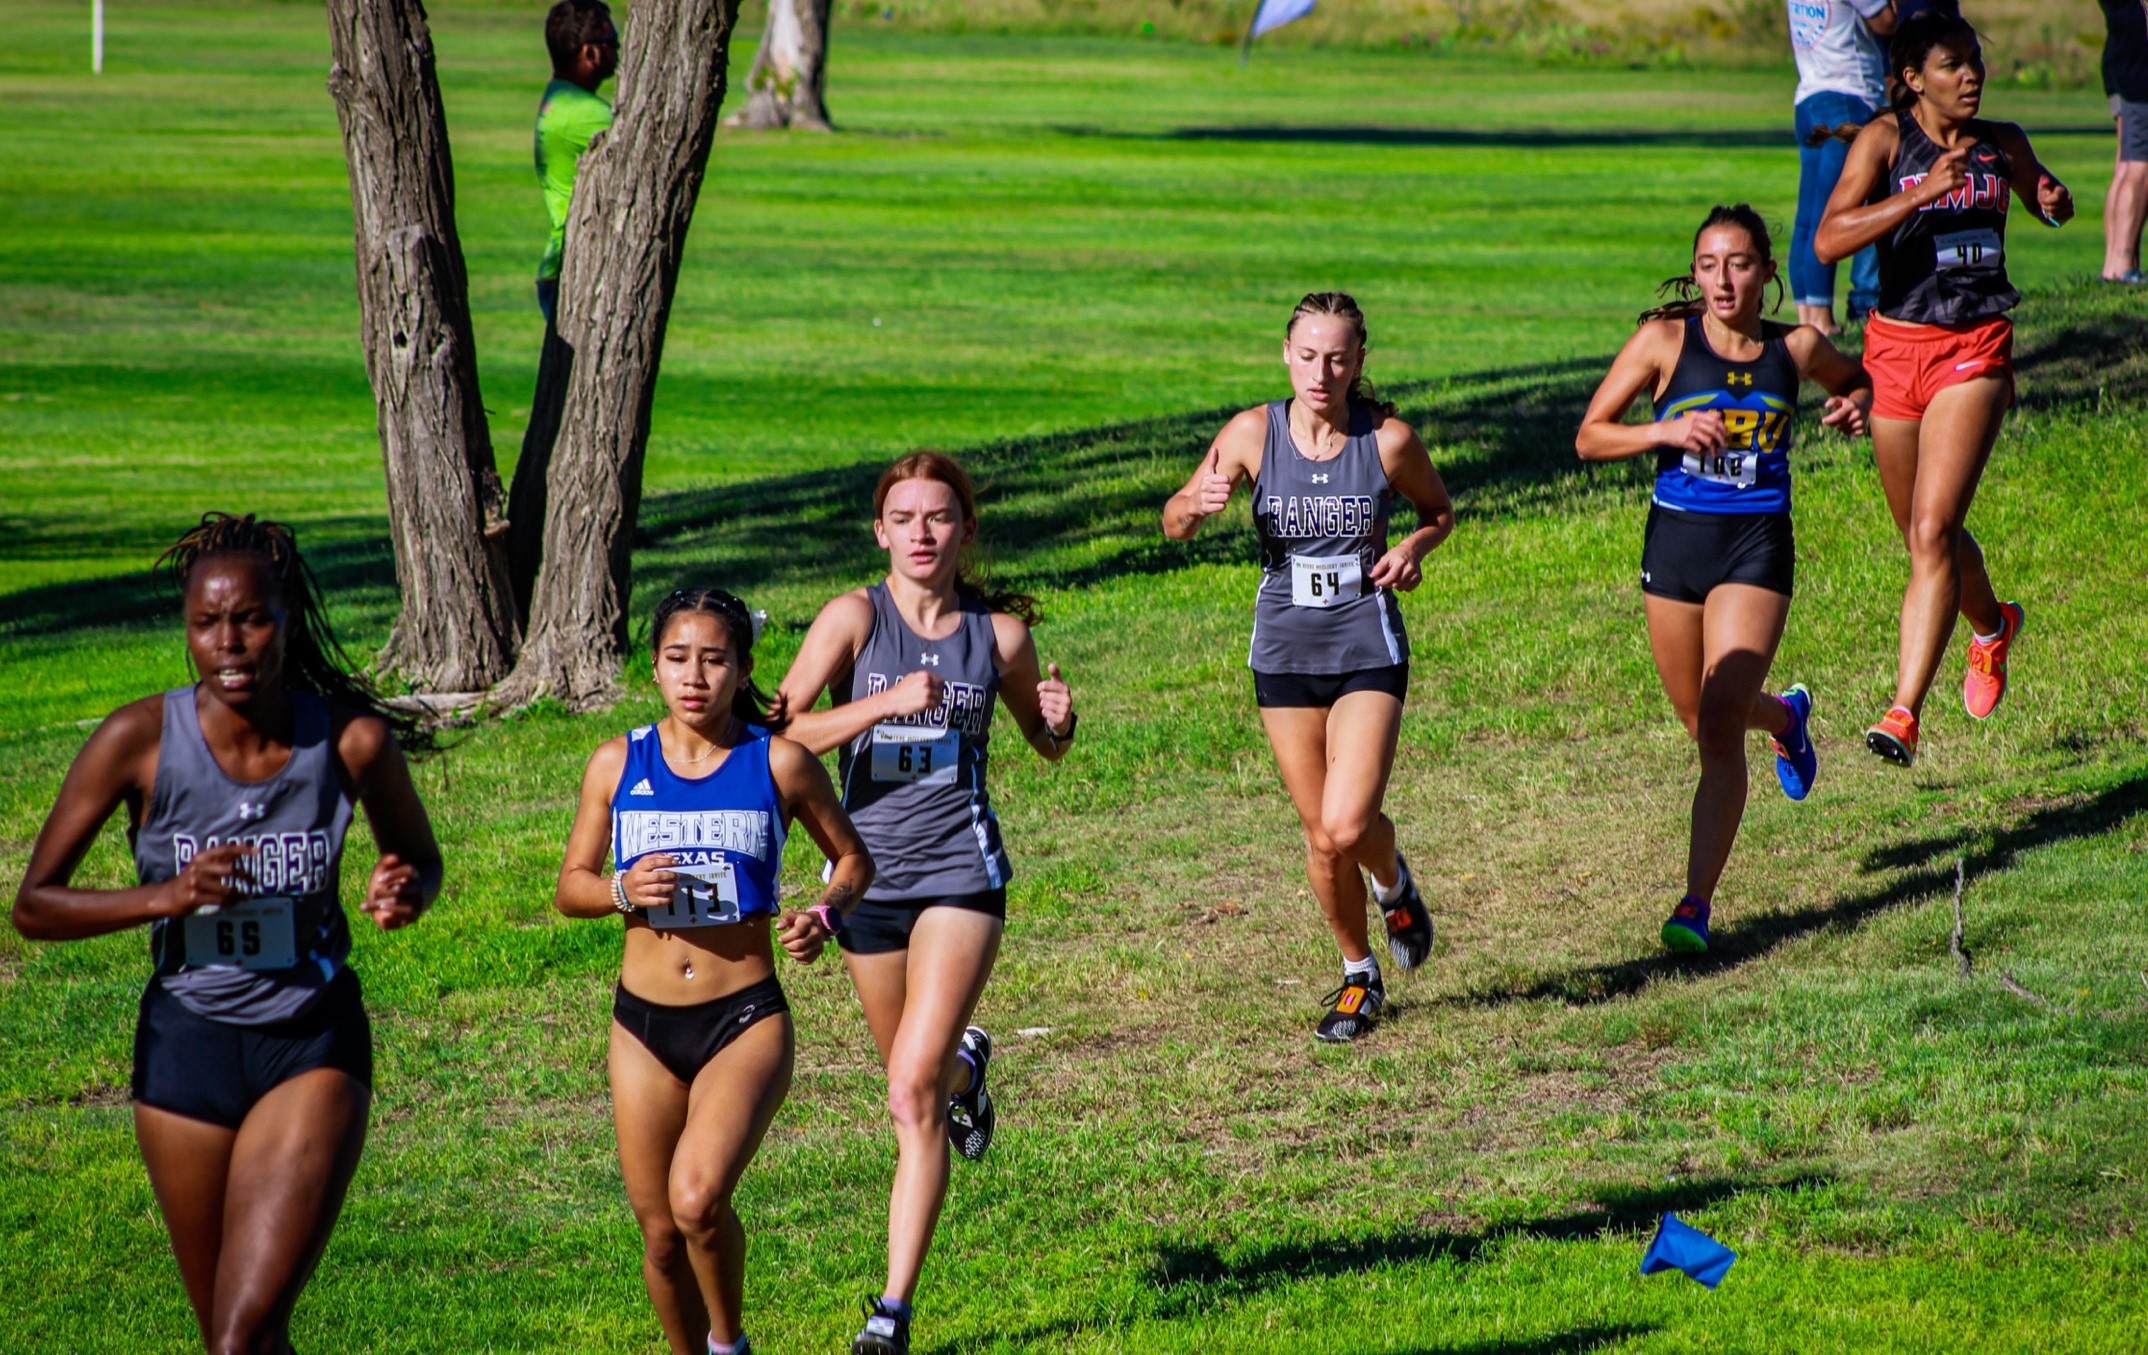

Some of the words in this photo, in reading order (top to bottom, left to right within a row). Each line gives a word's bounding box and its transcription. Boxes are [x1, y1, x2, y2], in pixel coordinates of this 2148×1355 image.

[1956, 242, 1982, 265] 40
[1683, 408, 1789, 454] BU
[1267, 495, 1374, 538] RANGER
[1311, 572, 1340, 597] 64
[899, 745, 932, 774] 63
[619, 810, 769, 862] WESTERN
[173, 831, 331, 895] RNGER
[664, 851, 725, 866] EXAS
[217, 920, 260, 956] 65
